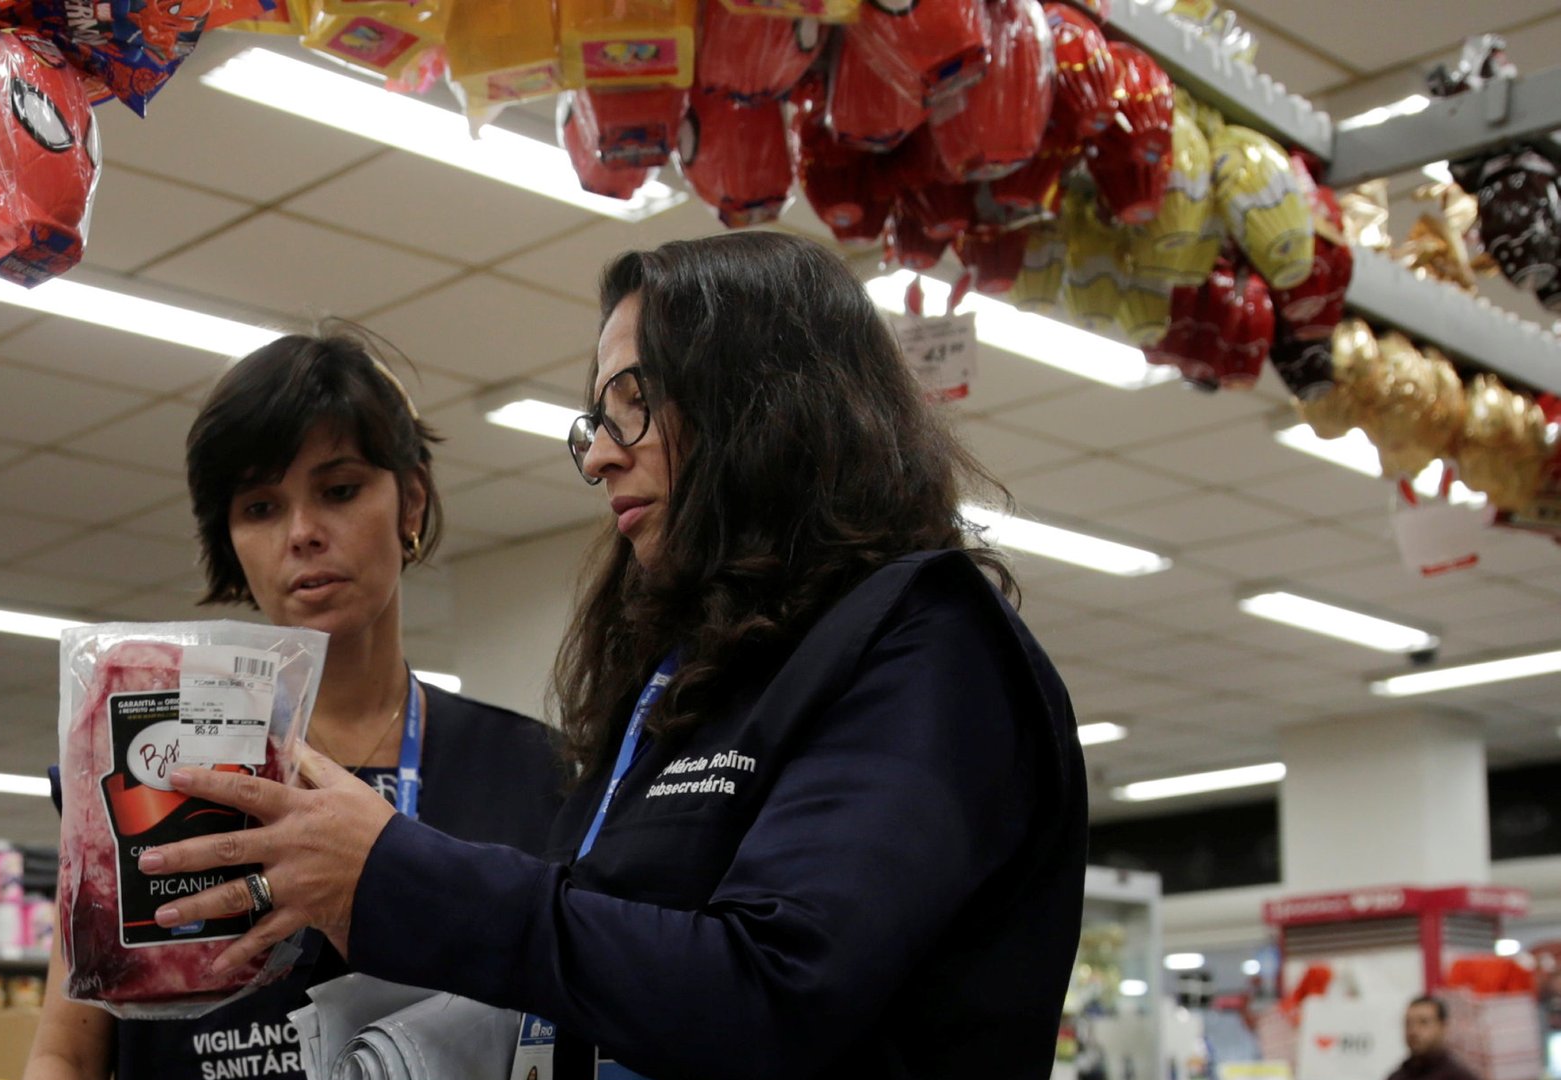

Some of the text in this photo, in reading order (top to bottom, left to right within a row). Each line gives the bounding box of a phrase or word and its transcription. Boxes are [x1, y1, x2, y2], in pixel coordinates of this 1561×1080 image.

[118, 700, 156, 708] GARANTIA
[708, 749, 757, 774] Rolim
[193, 1022, 299, 1055] VIGILÂNC
